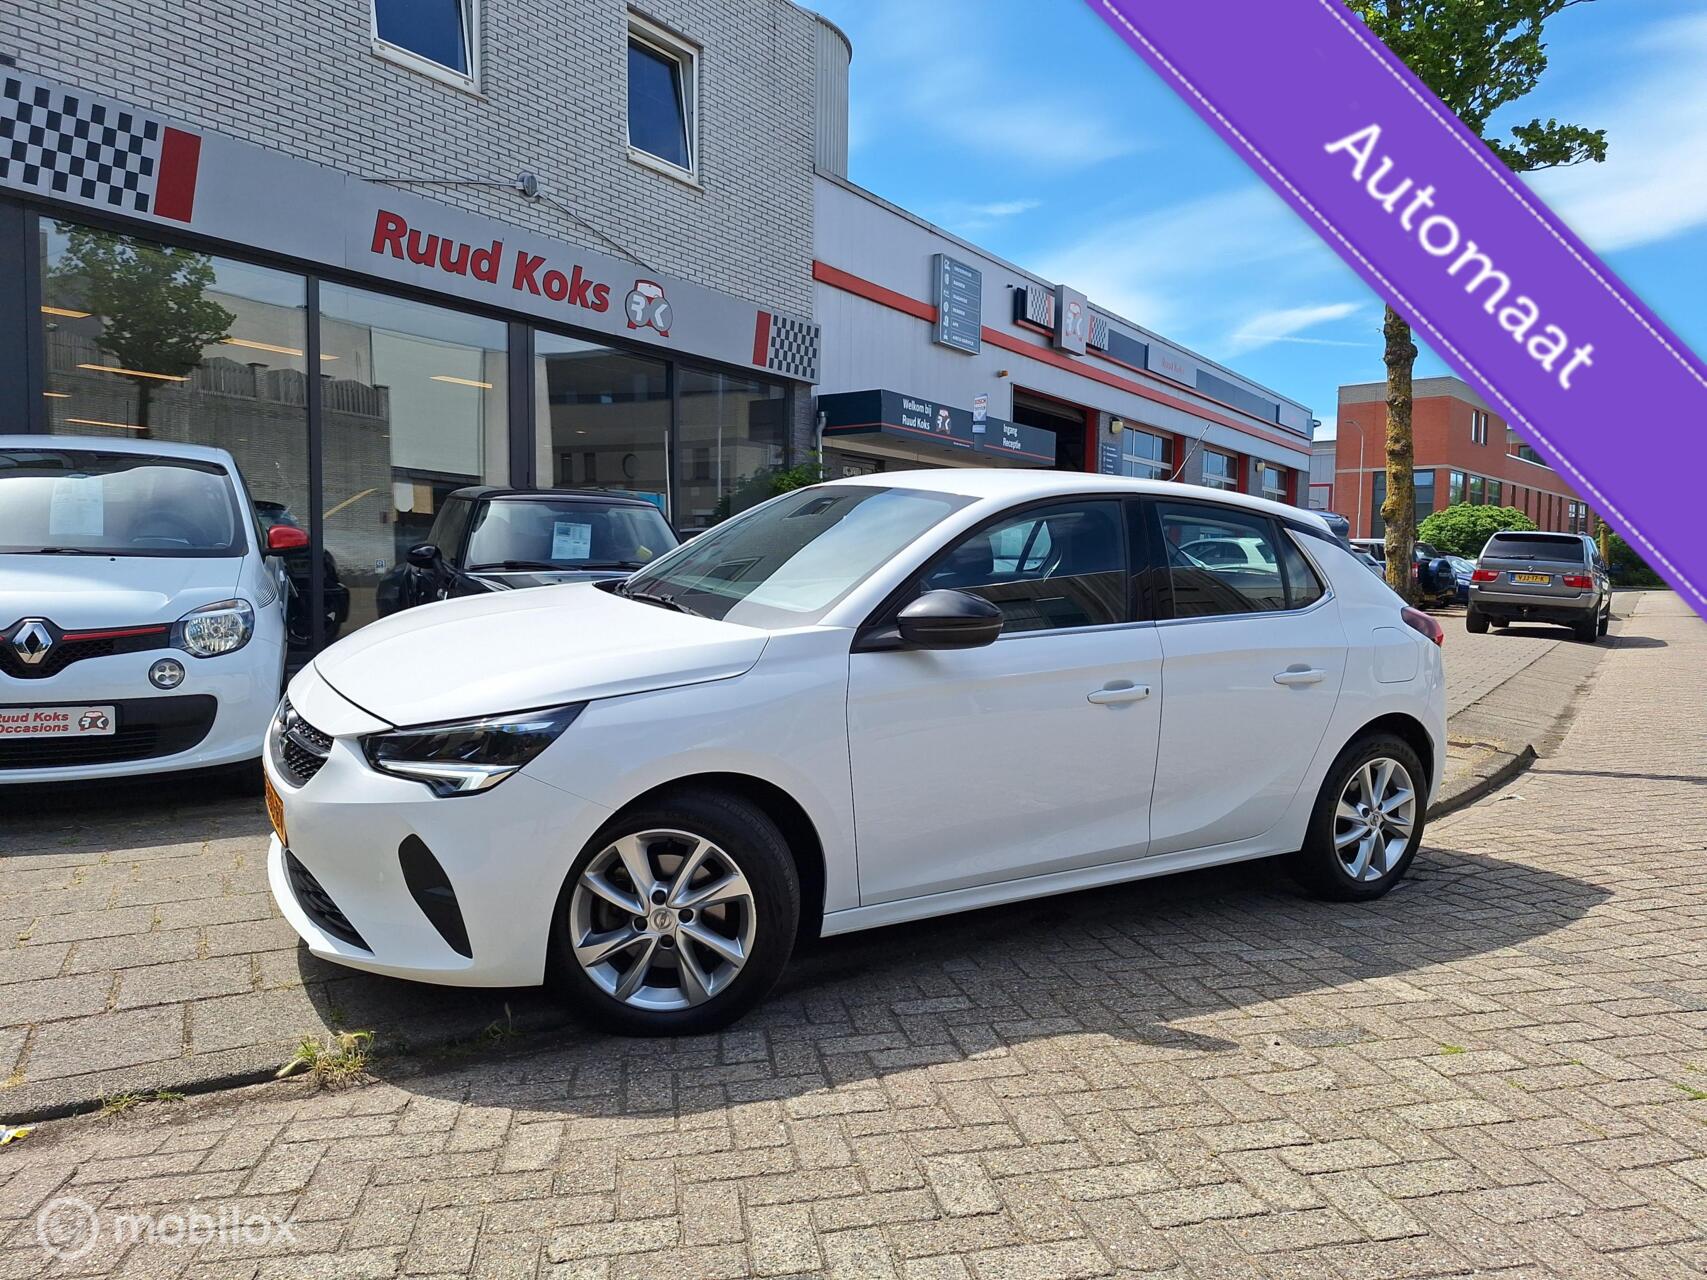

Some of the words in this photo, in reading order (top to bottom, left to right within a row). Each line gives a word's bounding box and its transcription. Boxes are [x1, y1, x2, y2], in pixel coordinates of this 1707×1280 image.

[371, 209, 503, 284] Ruud
[512, 250, 611, 313] Koks
[902, 398, 925, 413] Welkom
[902, 414, 917, 427] Ruud
[917, 418, 930, 430] Koks
[1003, 424, 1018, 437] Ingang
[1002, 437, 1021, 450] Receptie
[0, 713, 30, 723] uud
[33, 712, 70, 722] Koks
